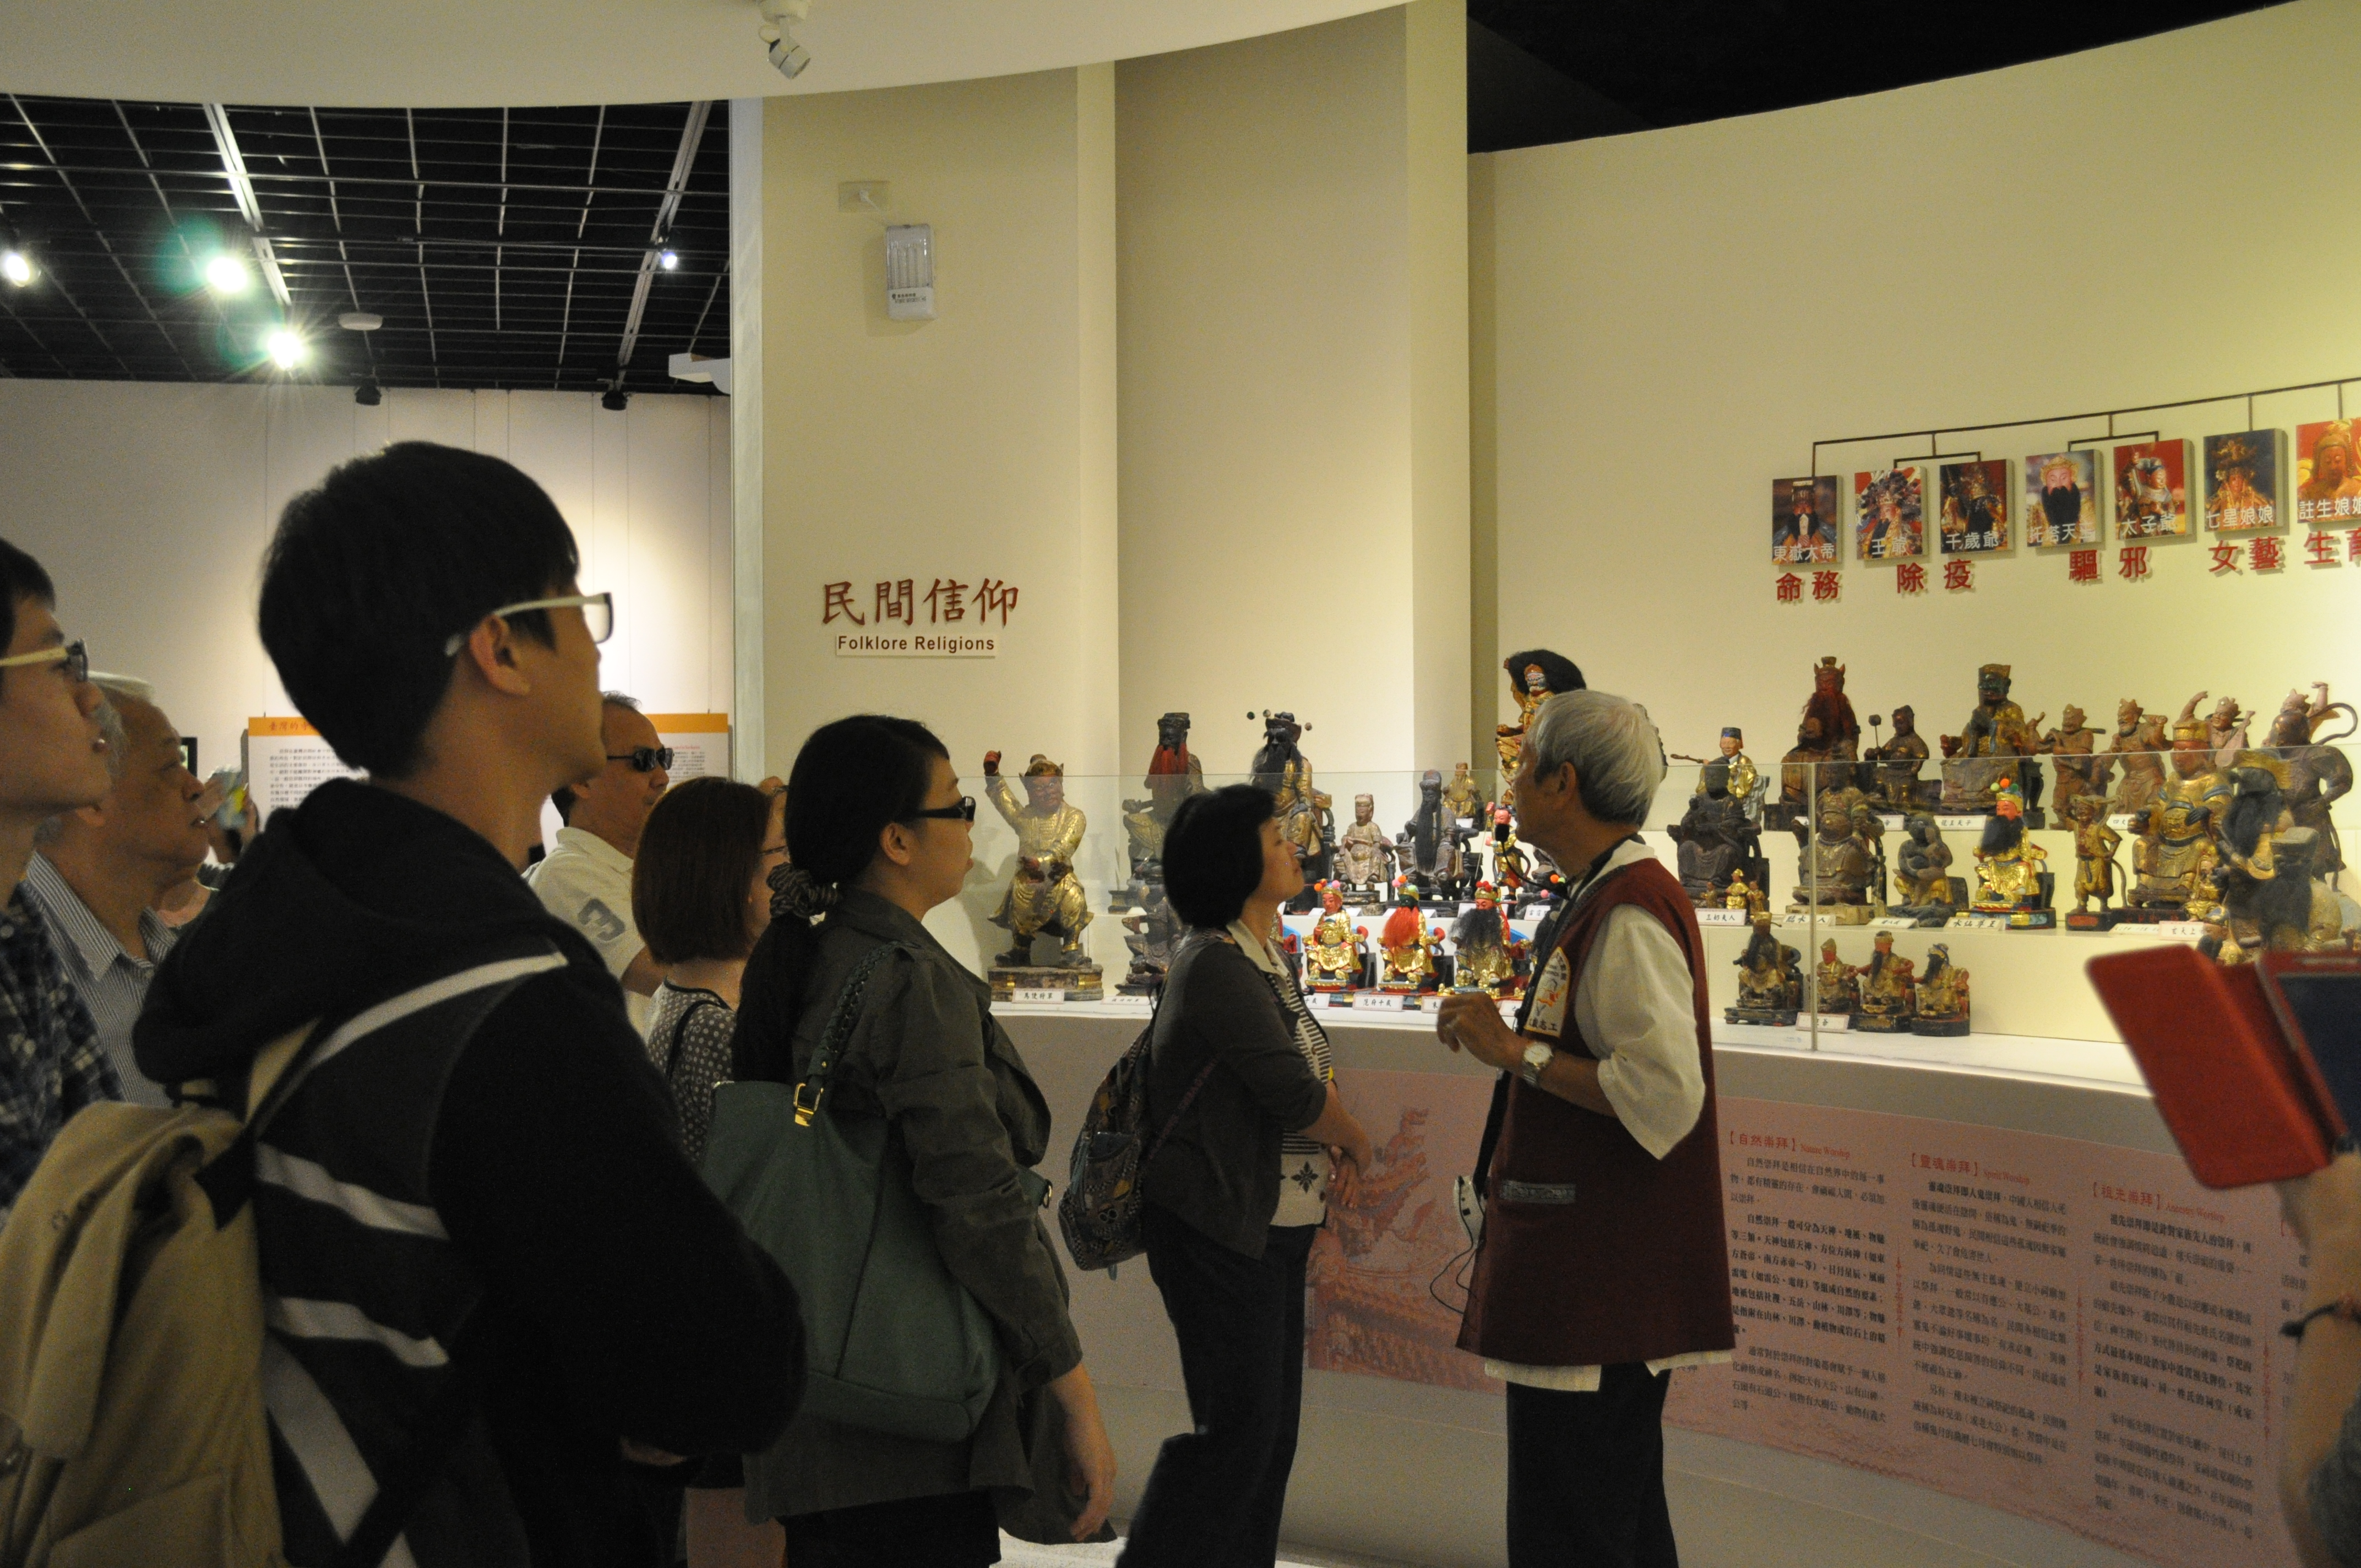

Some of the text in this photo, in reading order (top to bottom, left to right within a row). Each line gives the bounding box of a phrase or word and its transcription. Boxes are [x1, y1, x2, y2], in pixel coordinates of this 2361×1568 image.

[2205, 506, 2274, 529] 七星娘娘
[2299, 496, 2361, 519] 註生娘娘
[2029, 521, 2095, 543] 托塔天王
[2121, 514, 2178, 538] 太子爺
[1872, 536, 1907, 556] 王爺
[1946, 531, 2000, 549] 千歲爺
[1774, 543, 1835, 561] 東嶽大帝
[2208, 536, 2280, 573] 女藝
[2068, 546, 2148, 582] 驅邪
[1776, 570, 1839, 601] 命務
[1896, 559, 1973, 594] 除疫
[822, 578, 1019, 627] 民間信仰
[838, 635, 994, 654] Folklore Religions
[1730, 1130, 1796, 1152] 【自然崇拜】
[1800, 1143, 1849, 1159] Nature Worship
[2003, 1172, 2030, 1186] Worship
